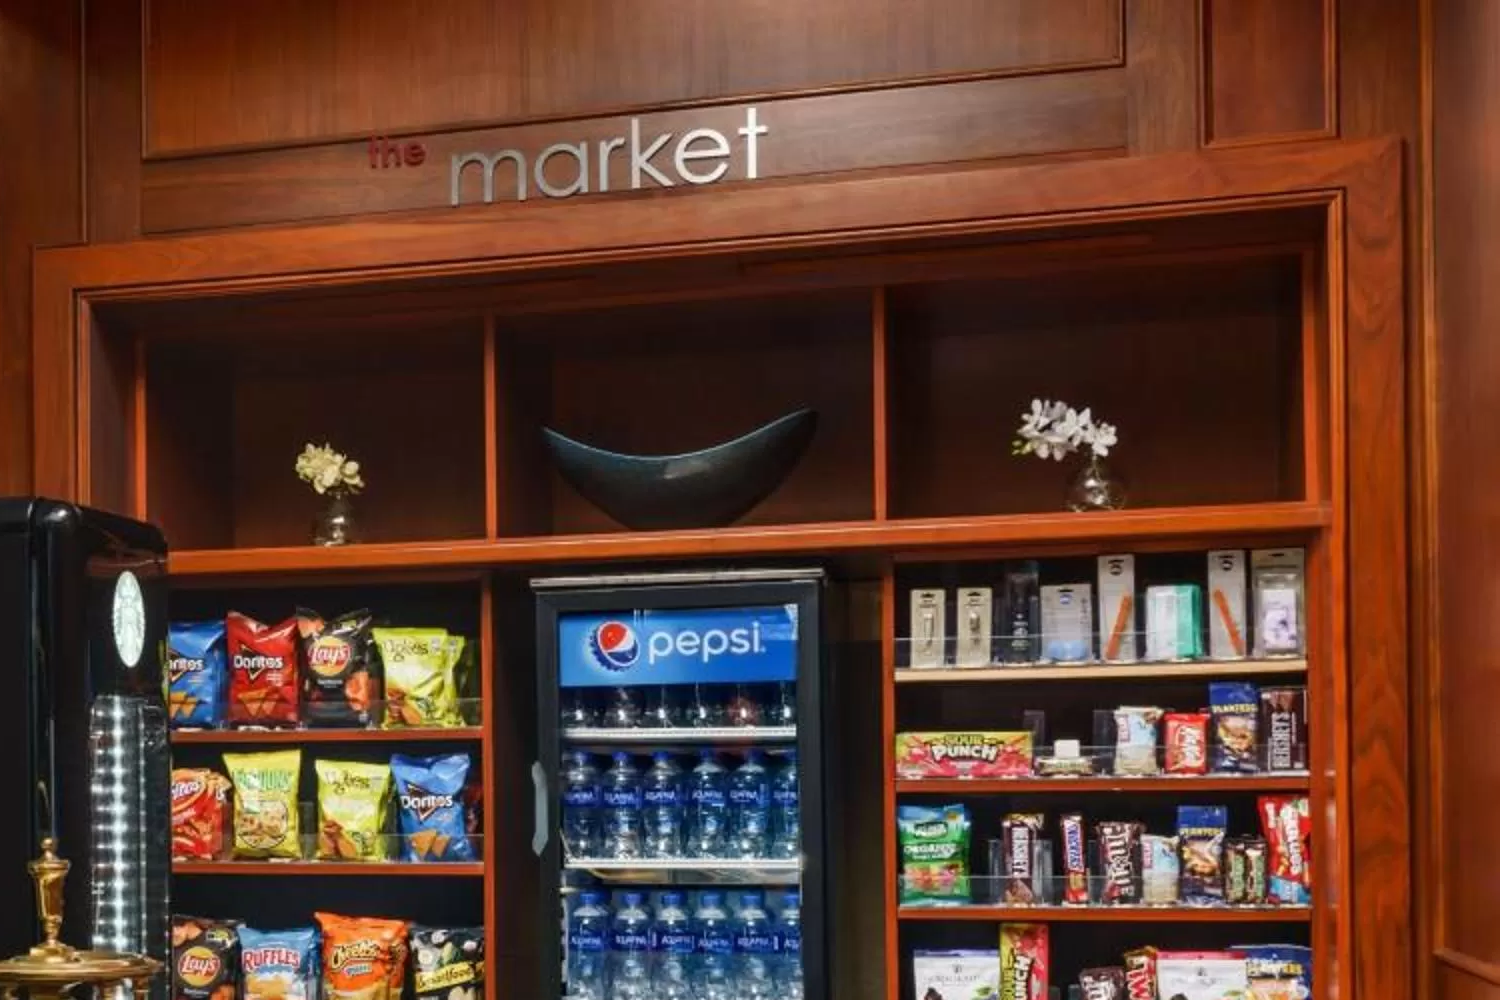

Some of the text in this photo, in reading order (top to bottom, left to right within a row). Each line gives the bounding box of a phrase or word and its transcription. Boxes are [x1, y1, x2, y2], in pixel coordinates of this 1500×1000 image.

[367, 107, 770, 207] the market
[648, 620, 762, 665] pepsi
[233, 655, 284, 669] Doritos
[931, 744, 999, 763] PUNCH
[401, 795, 454, 809] Doritos
[243, 948, 300, 970] RUFFLES
